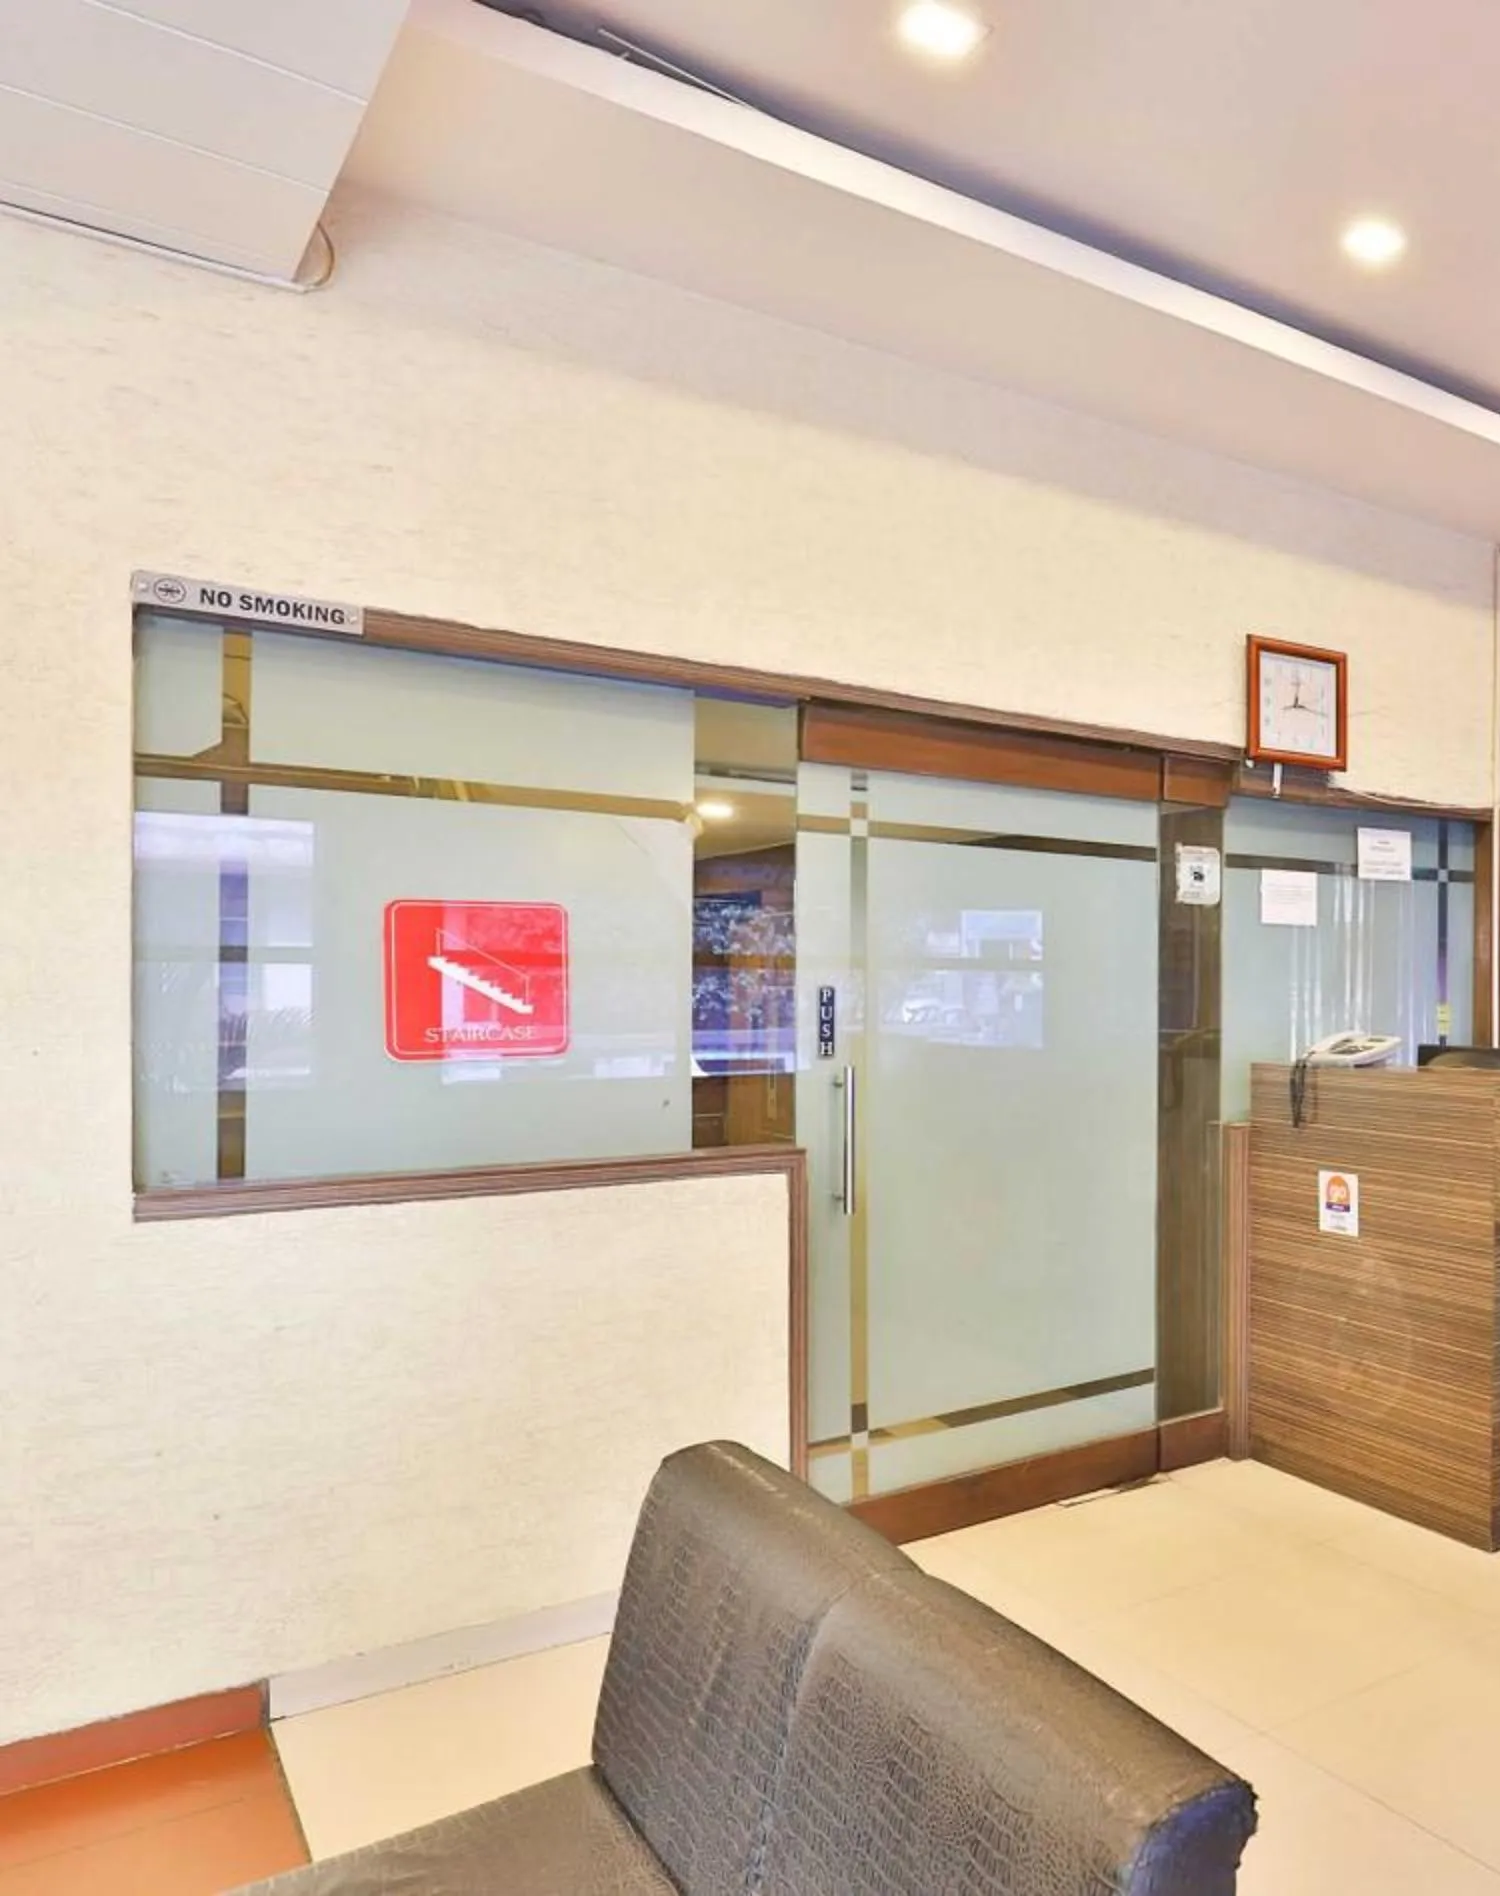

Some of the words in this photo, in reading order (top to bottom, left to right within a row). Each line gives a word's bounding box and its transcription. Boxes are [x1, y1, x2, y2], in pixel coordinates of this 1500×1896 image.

[200, 587, 232, 608] NO
[239, 595, 345, 625] SMOKING
[424, 1024, 537, 1043] STAIRCASE
[821, 988, 833, 1055] PUSH
